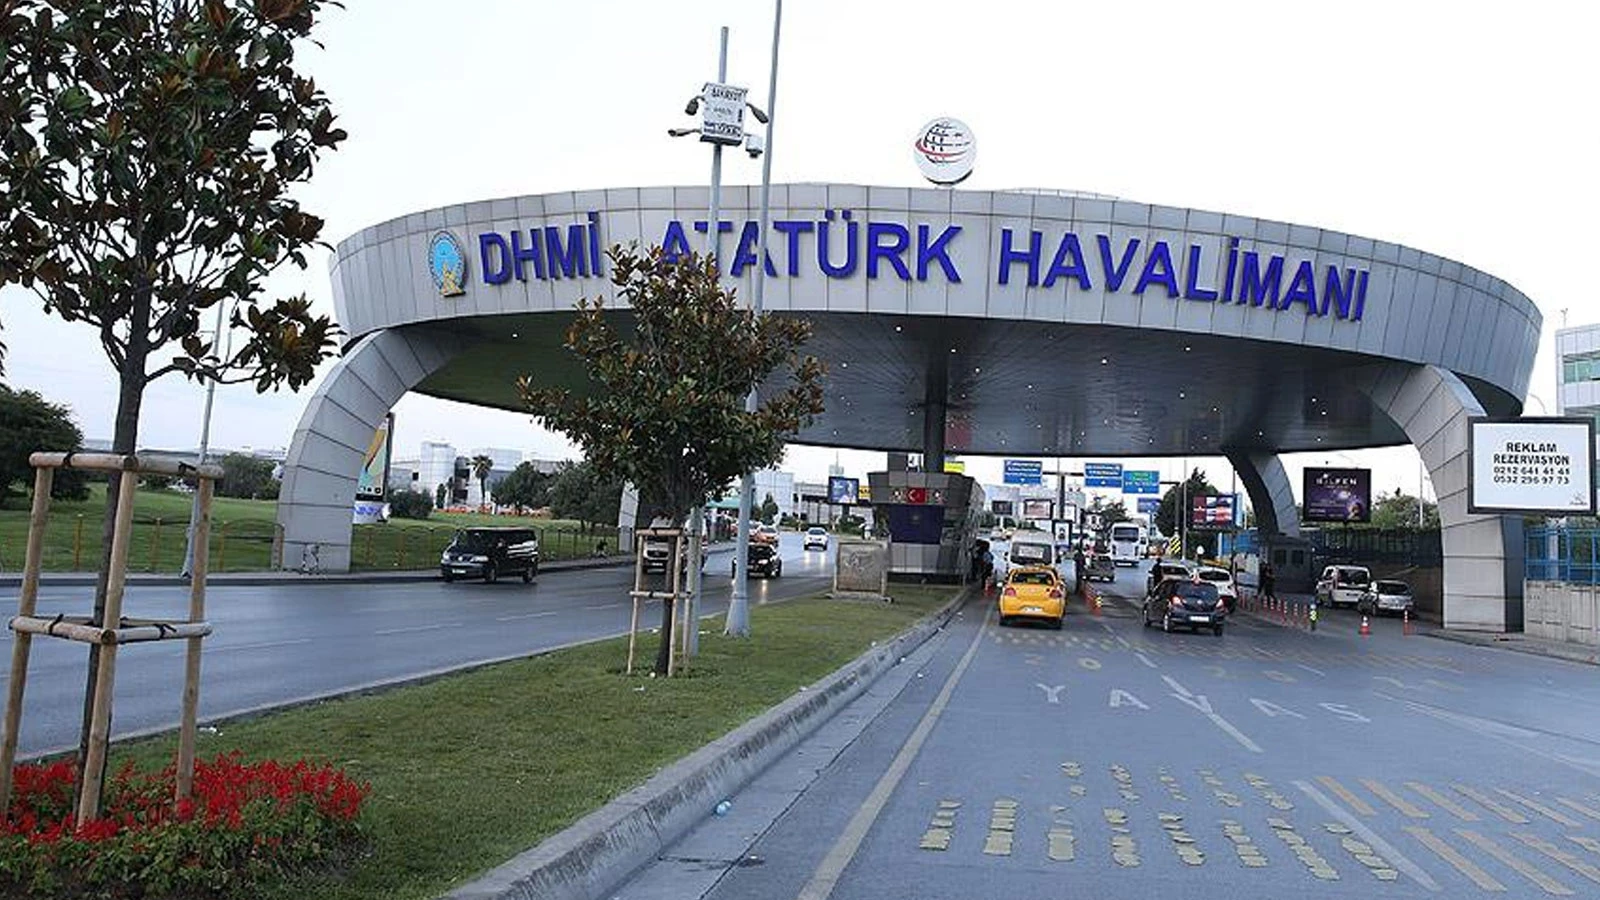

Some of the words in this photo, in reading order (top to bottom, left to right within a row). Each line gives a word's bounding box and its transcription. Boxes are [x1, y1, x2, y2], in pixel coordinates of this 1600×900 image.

[479, 211, 600, 285] DHMİ
[998, 228, 1370, 321] HAVALİMANI
[1506, 442, 1557, 453] REKLAM
[1493, 454, 1570, 465] REZERVASYON
[1493, 466, 1519, 475] 0212
[1520, 466, 1539, 476] 641
[1493, 475, 1519, 484] 0532
